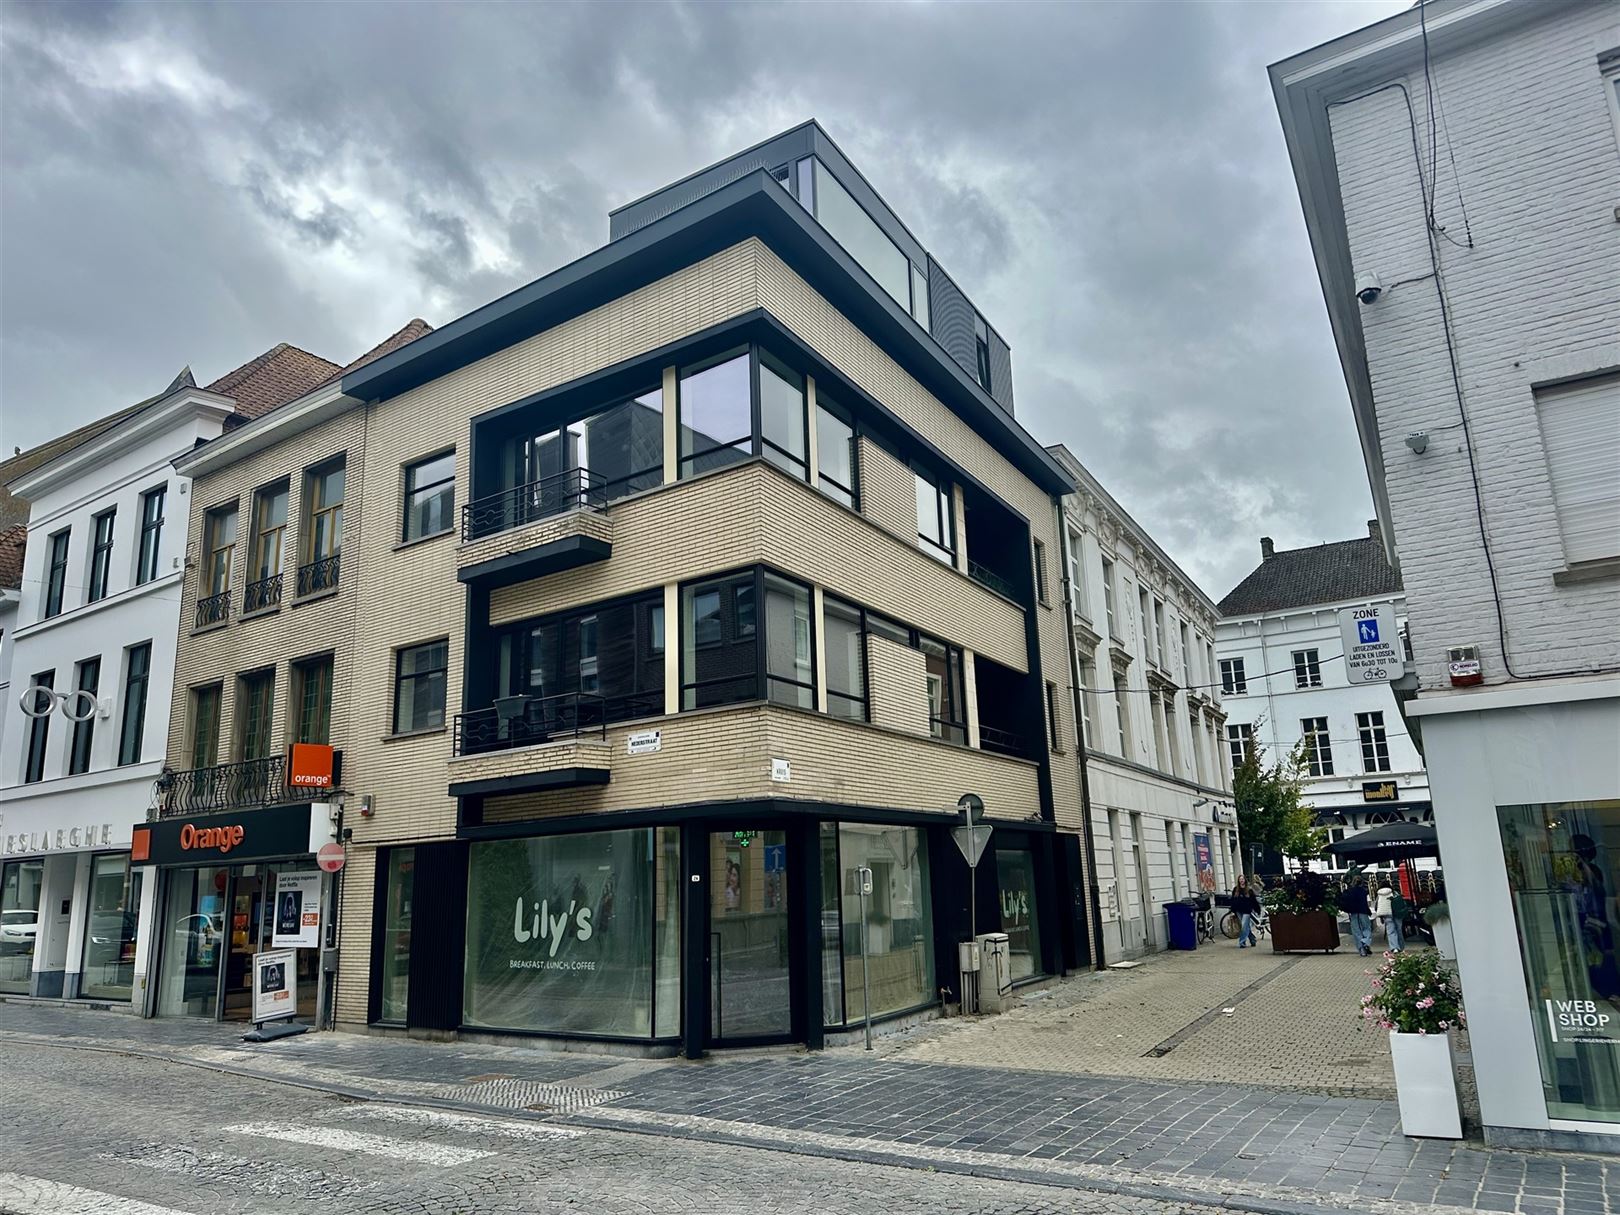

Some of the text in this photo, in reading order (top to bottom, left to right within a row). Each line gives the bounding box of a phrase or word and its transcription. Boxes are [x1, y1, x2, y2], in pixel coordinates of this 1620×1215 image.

[1352, 608, 1379, 620] ZONE
[1352, 642, 1390, 653] UITGEZONDERD
[1349, 649, 1396, 661] LADEN EN LOSSEN
[1349, 660, 1361, 668] VAN
[1377, 658, 1387, 666] TOT
[631, 737, 658, 747] NEDERSTRAAT
[294, 774, 329, 786] orange
[180, 823, 245, 854] Orange
[1385, 839, 1422, 847] ENAME
[1002, 889, 1028, 926] Lily's
[514, 896, 593, 958] Lily's
[571, 961, 596, 971] COFFEE
[1556, 1000, 1597, 1013] WEB
[1559, 1013, 1610, 1027] SHOP
